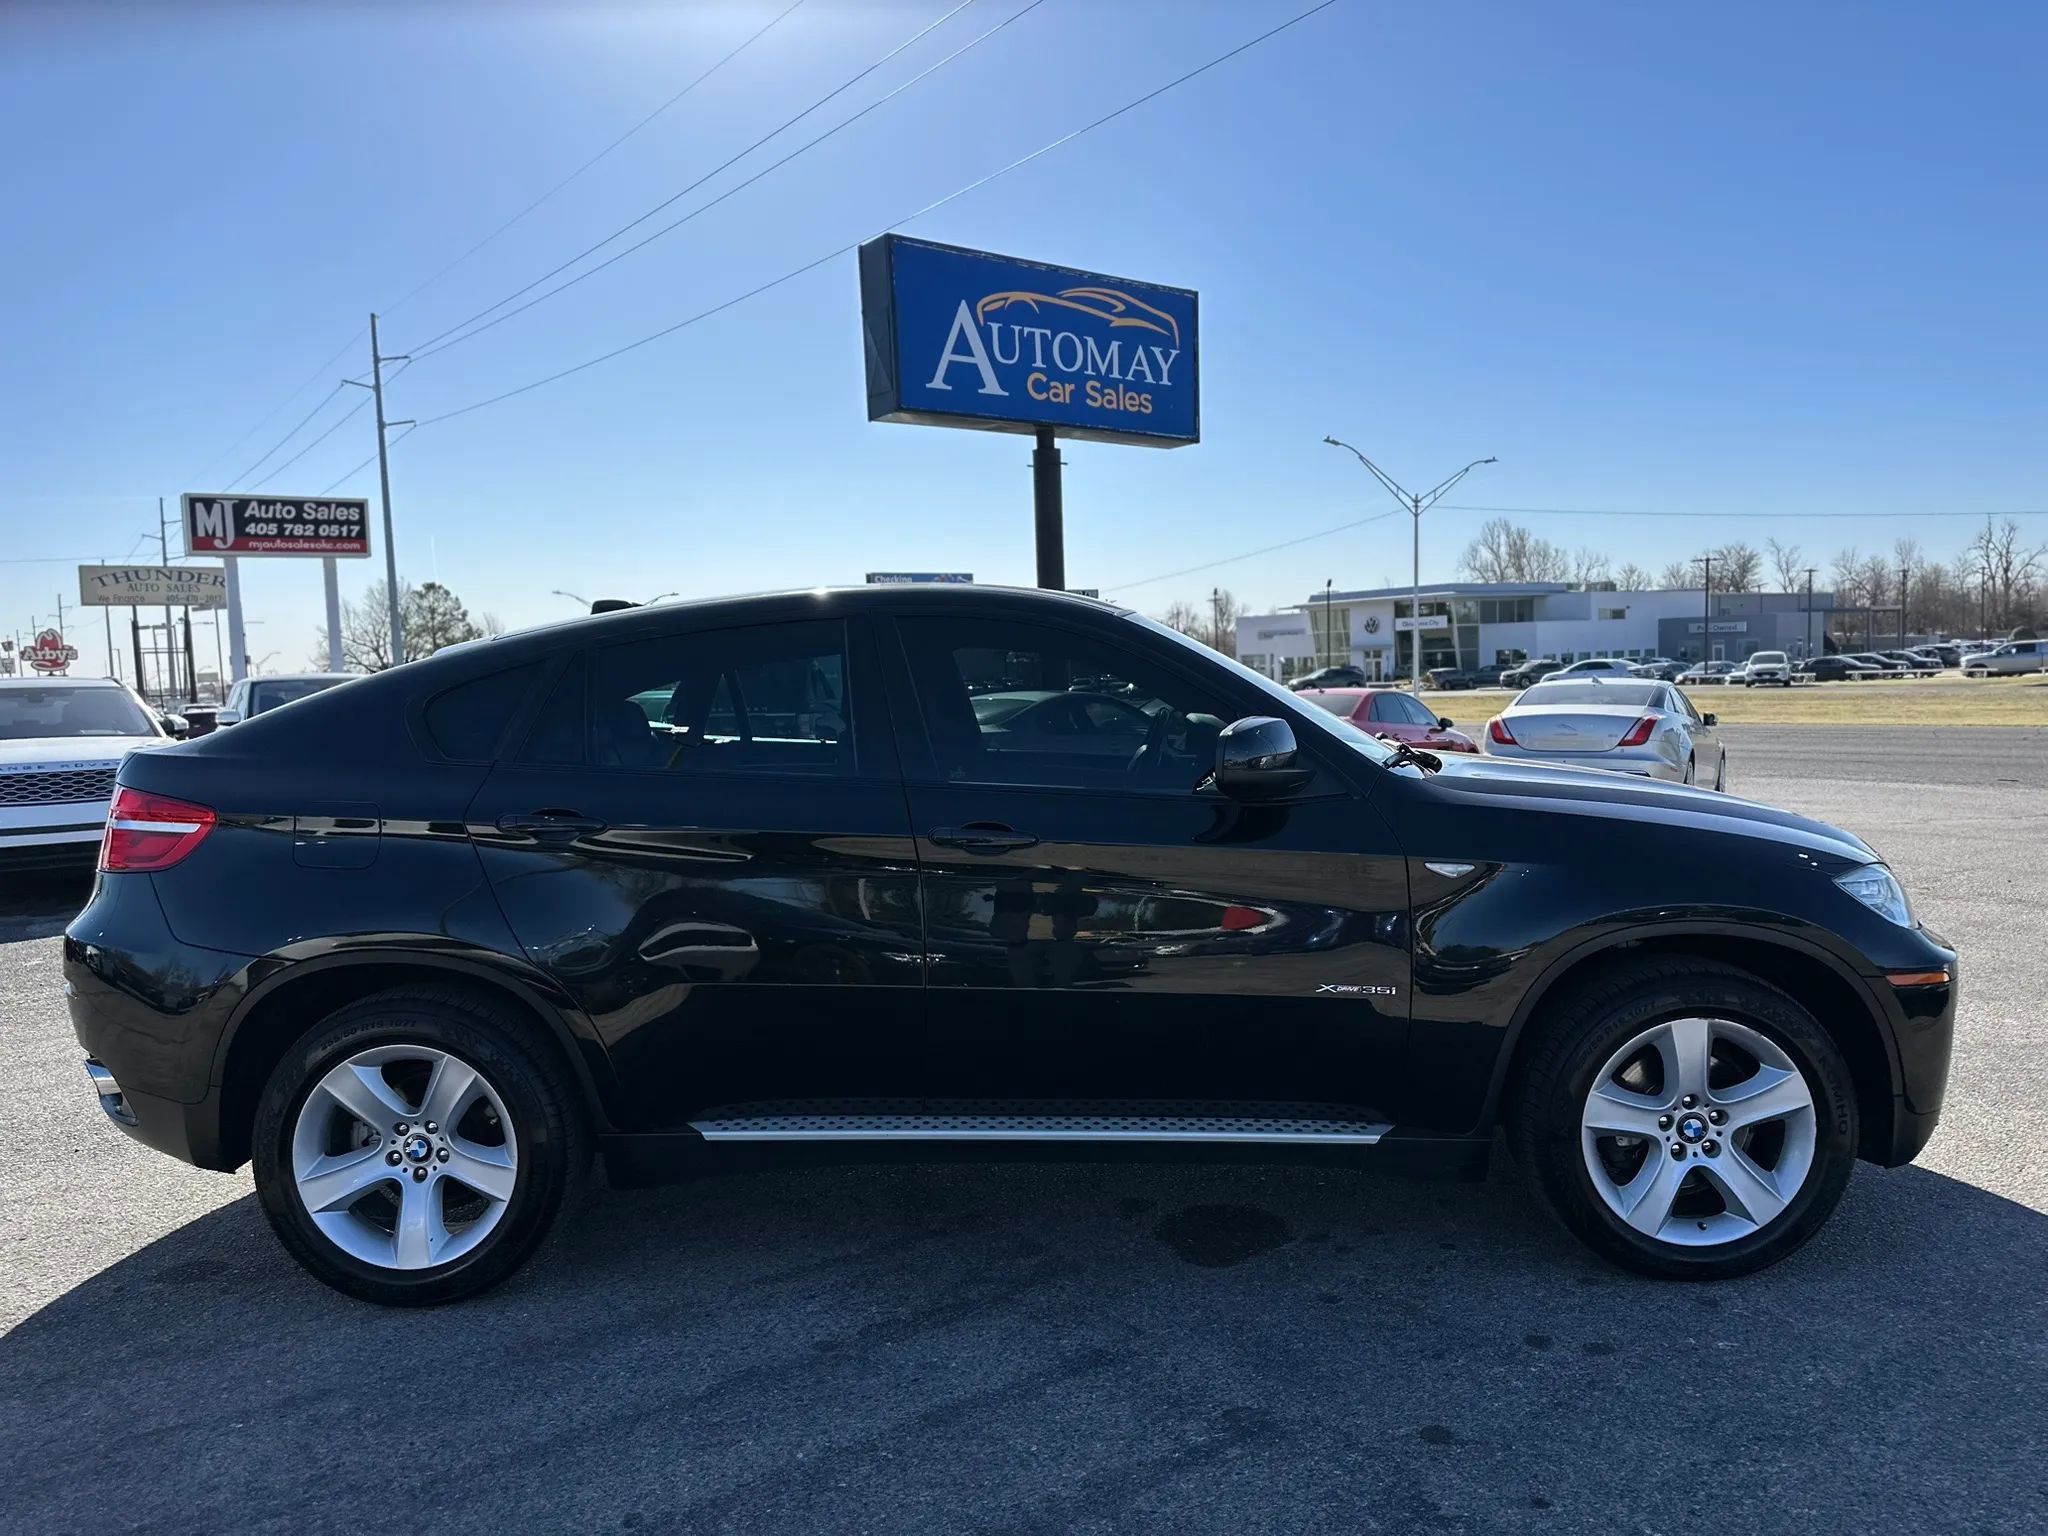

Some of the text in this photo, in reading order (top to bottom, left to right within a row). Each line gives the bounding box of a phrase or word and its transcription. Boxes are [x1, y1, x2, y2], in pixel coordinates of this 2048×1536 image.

[926, 299, 1180, 396] AUTOMAY
[1026, 372, 1153, 415] Car Sales
[244, 501, 360, 520] Auto Sales
[195, 499, 239, 549] MJ
[245, 523, 361, 537] 405 782 0517
[249, 540, 361, 551] mjautosalesokc.com
[91, 569, 226, 588] THUNDER
[127, 583, 200, 593] AUTO SALES
[22, 645, 78, 663] Arby's
